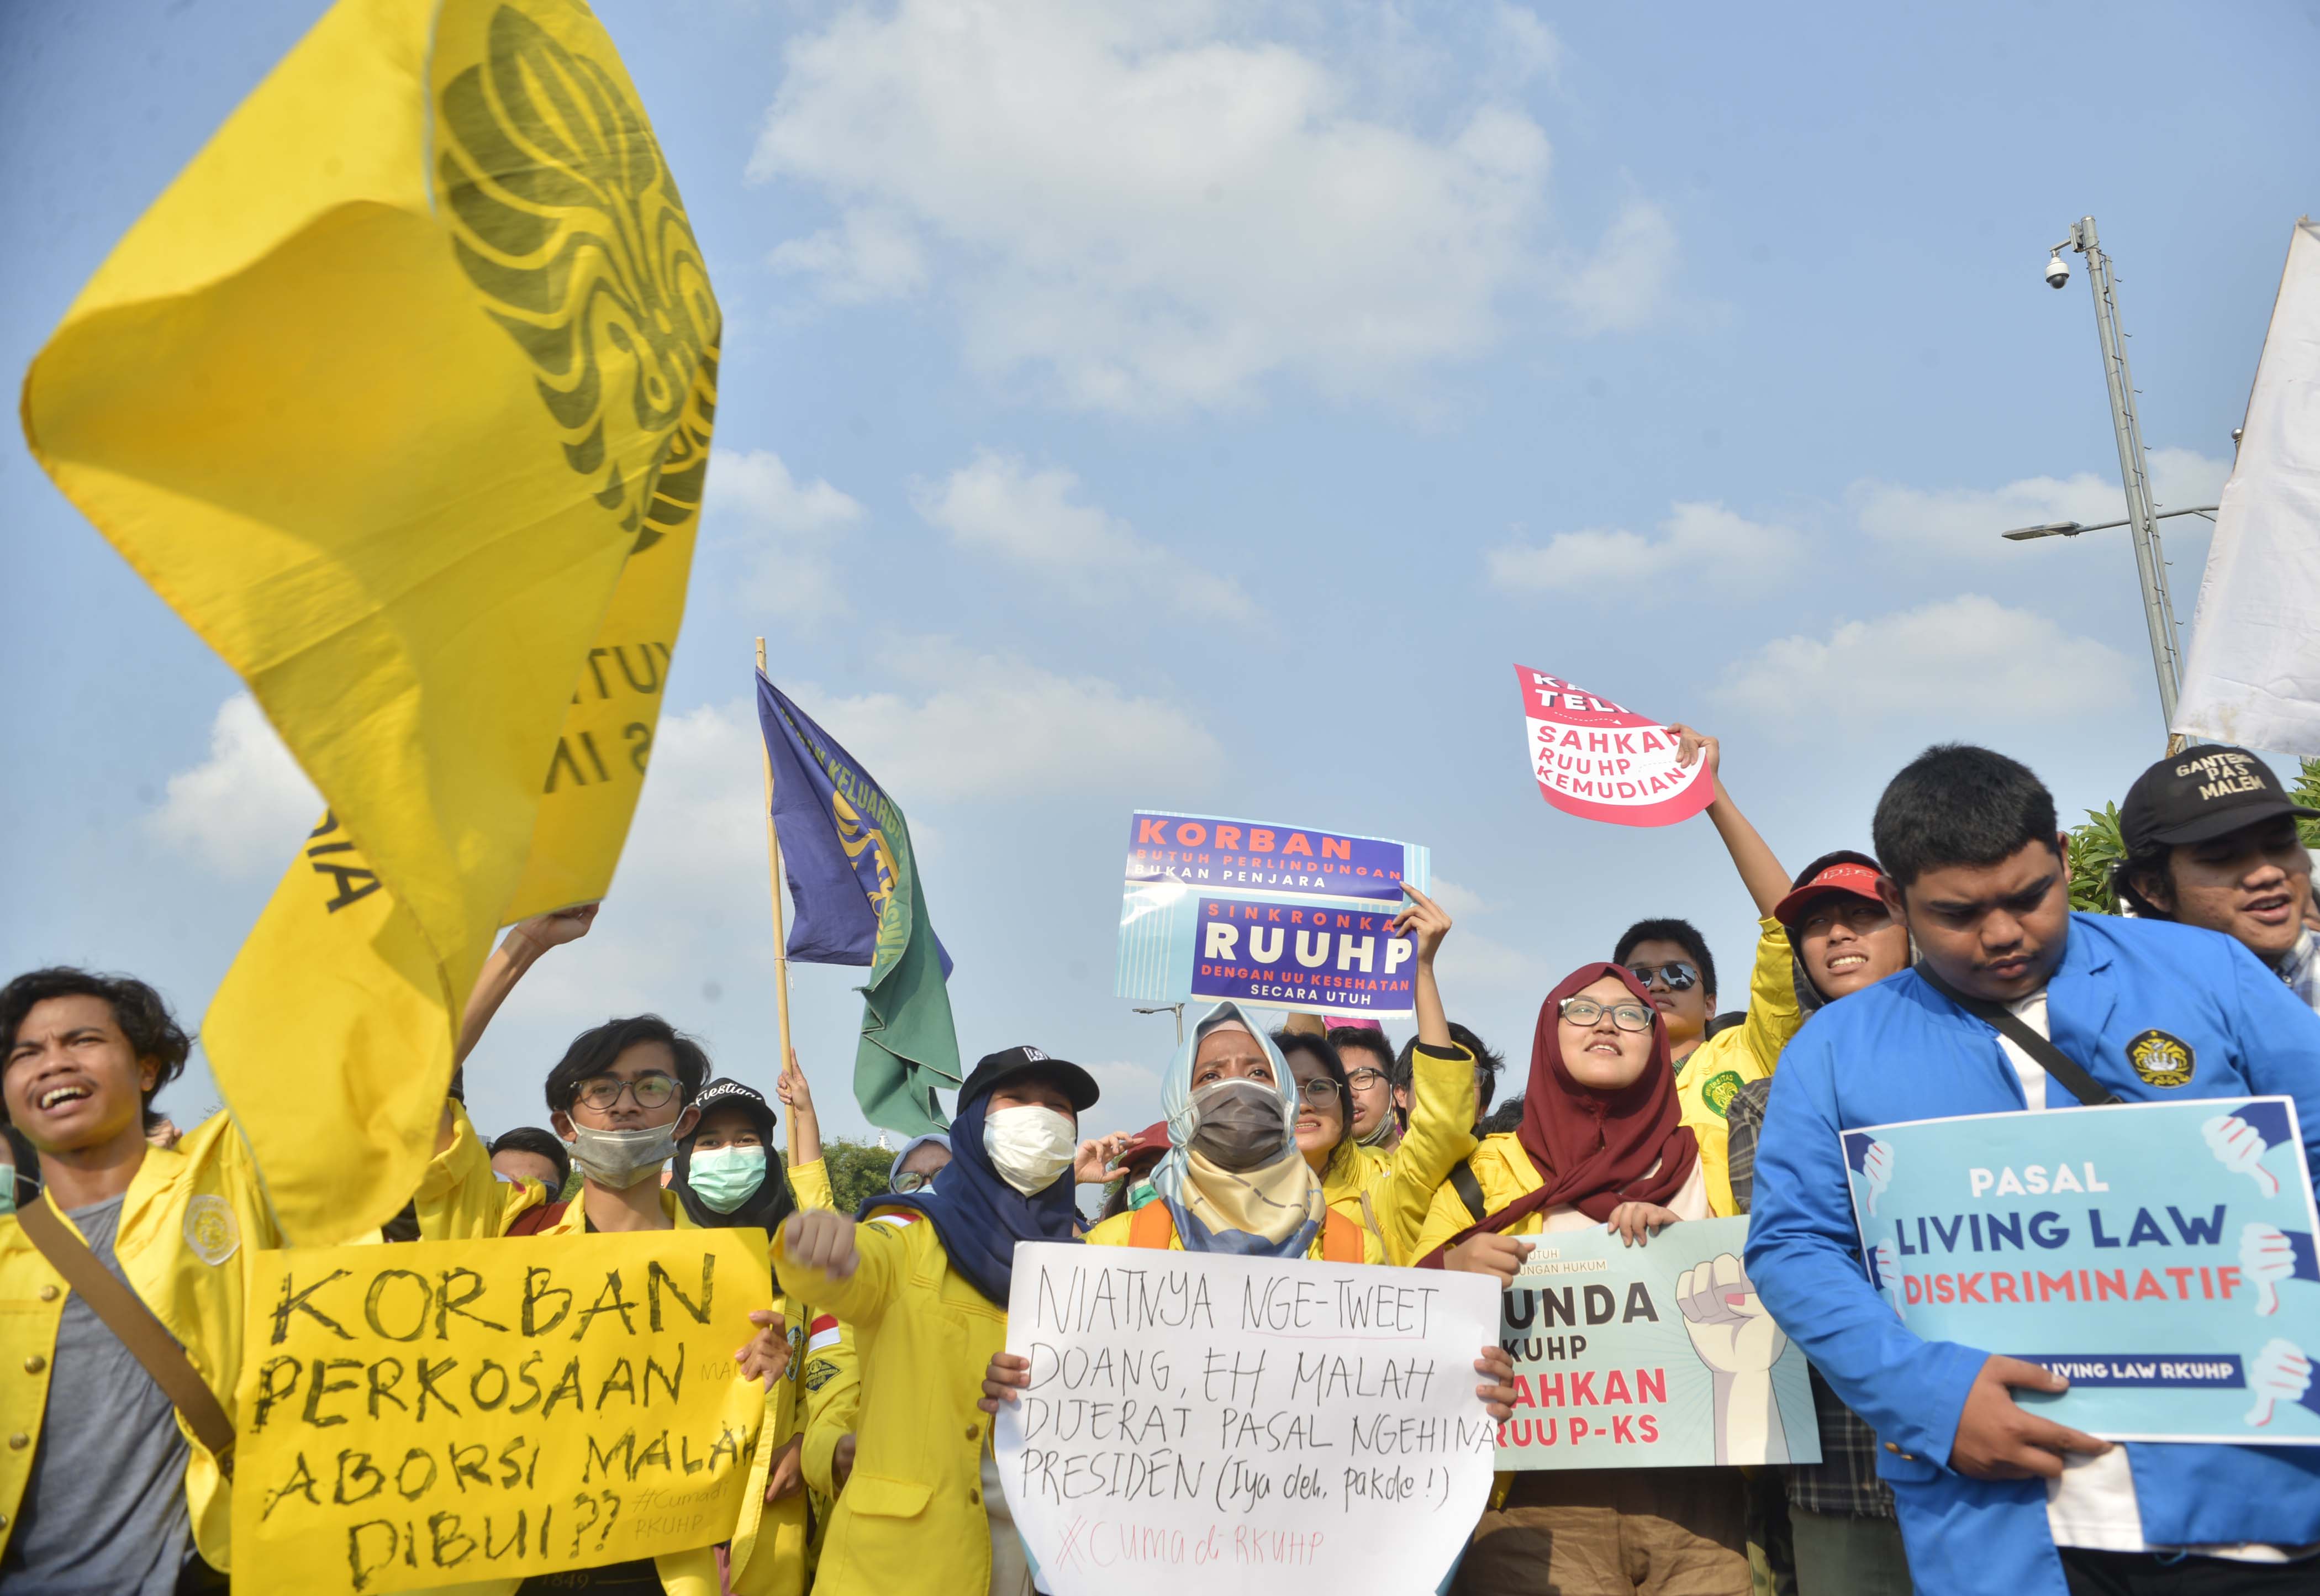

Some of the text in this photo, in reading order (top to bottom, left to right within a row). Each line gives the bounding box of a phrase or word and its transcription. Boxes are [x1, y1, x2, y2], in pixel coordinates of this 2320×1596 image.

[1537, 765, 1686, 799] KEMUDIAN
[2206, 763, 2249, 781] PAS
[1137, 819, 1351, 861] KORBAN
[1135, 863, 1326, 888] BUKAN PENJARA
[1136, 849, 1401, 880] BUTUH PERLINDUNGAN
[1208, 903, 1396, 932] SINKRONKA
[1204, 922, 1413, 974] RUUHP
[1201, 964, 1410, 991] DENGAN UU KESEHATAN
[1251, 984, 1371, 1005] SECARA UTUH
[1969, 1162, 2108, 1198] PASAL
[1895, 1204, 2227, 1256] LIVING LAW
[1520, 1261, 1606, 1276] UNGAN HUKUM
[1528, 1249, 1558, 1260] UTUH
[271, 1253, 715, 1344] KORBAN
[1036, 1264, 1439, 1339] NIATNYA NGE-TWEET
[1905, 1266, 2242, 1305] DISKRIMINATIF
[1502, 1282, 1659, 1330] UNDA
[1502, 1335, 1587, 1362] KUHP
[250, 1342, 684, 1434] PERKOSAAN
[1203, 1346, 1266, 1407] EH
[1291, 1351, 1435, 1403] MALAH
[1510, 1368, 1667, 1409] AHKAN
[2111, 1363, 2156, 1378] LAW
[2160, 1362, 2234, 1379] RKUHP
[1025, 1397, 1496, 1456] DIJERAT PASAL NGEHINA
[1569, 1414, 1659, 1446] P-KS
[262, 1421, 761, 1521] ABORSI MALAH
[1020, 1447, 1205, 1506] PRESIDEN
